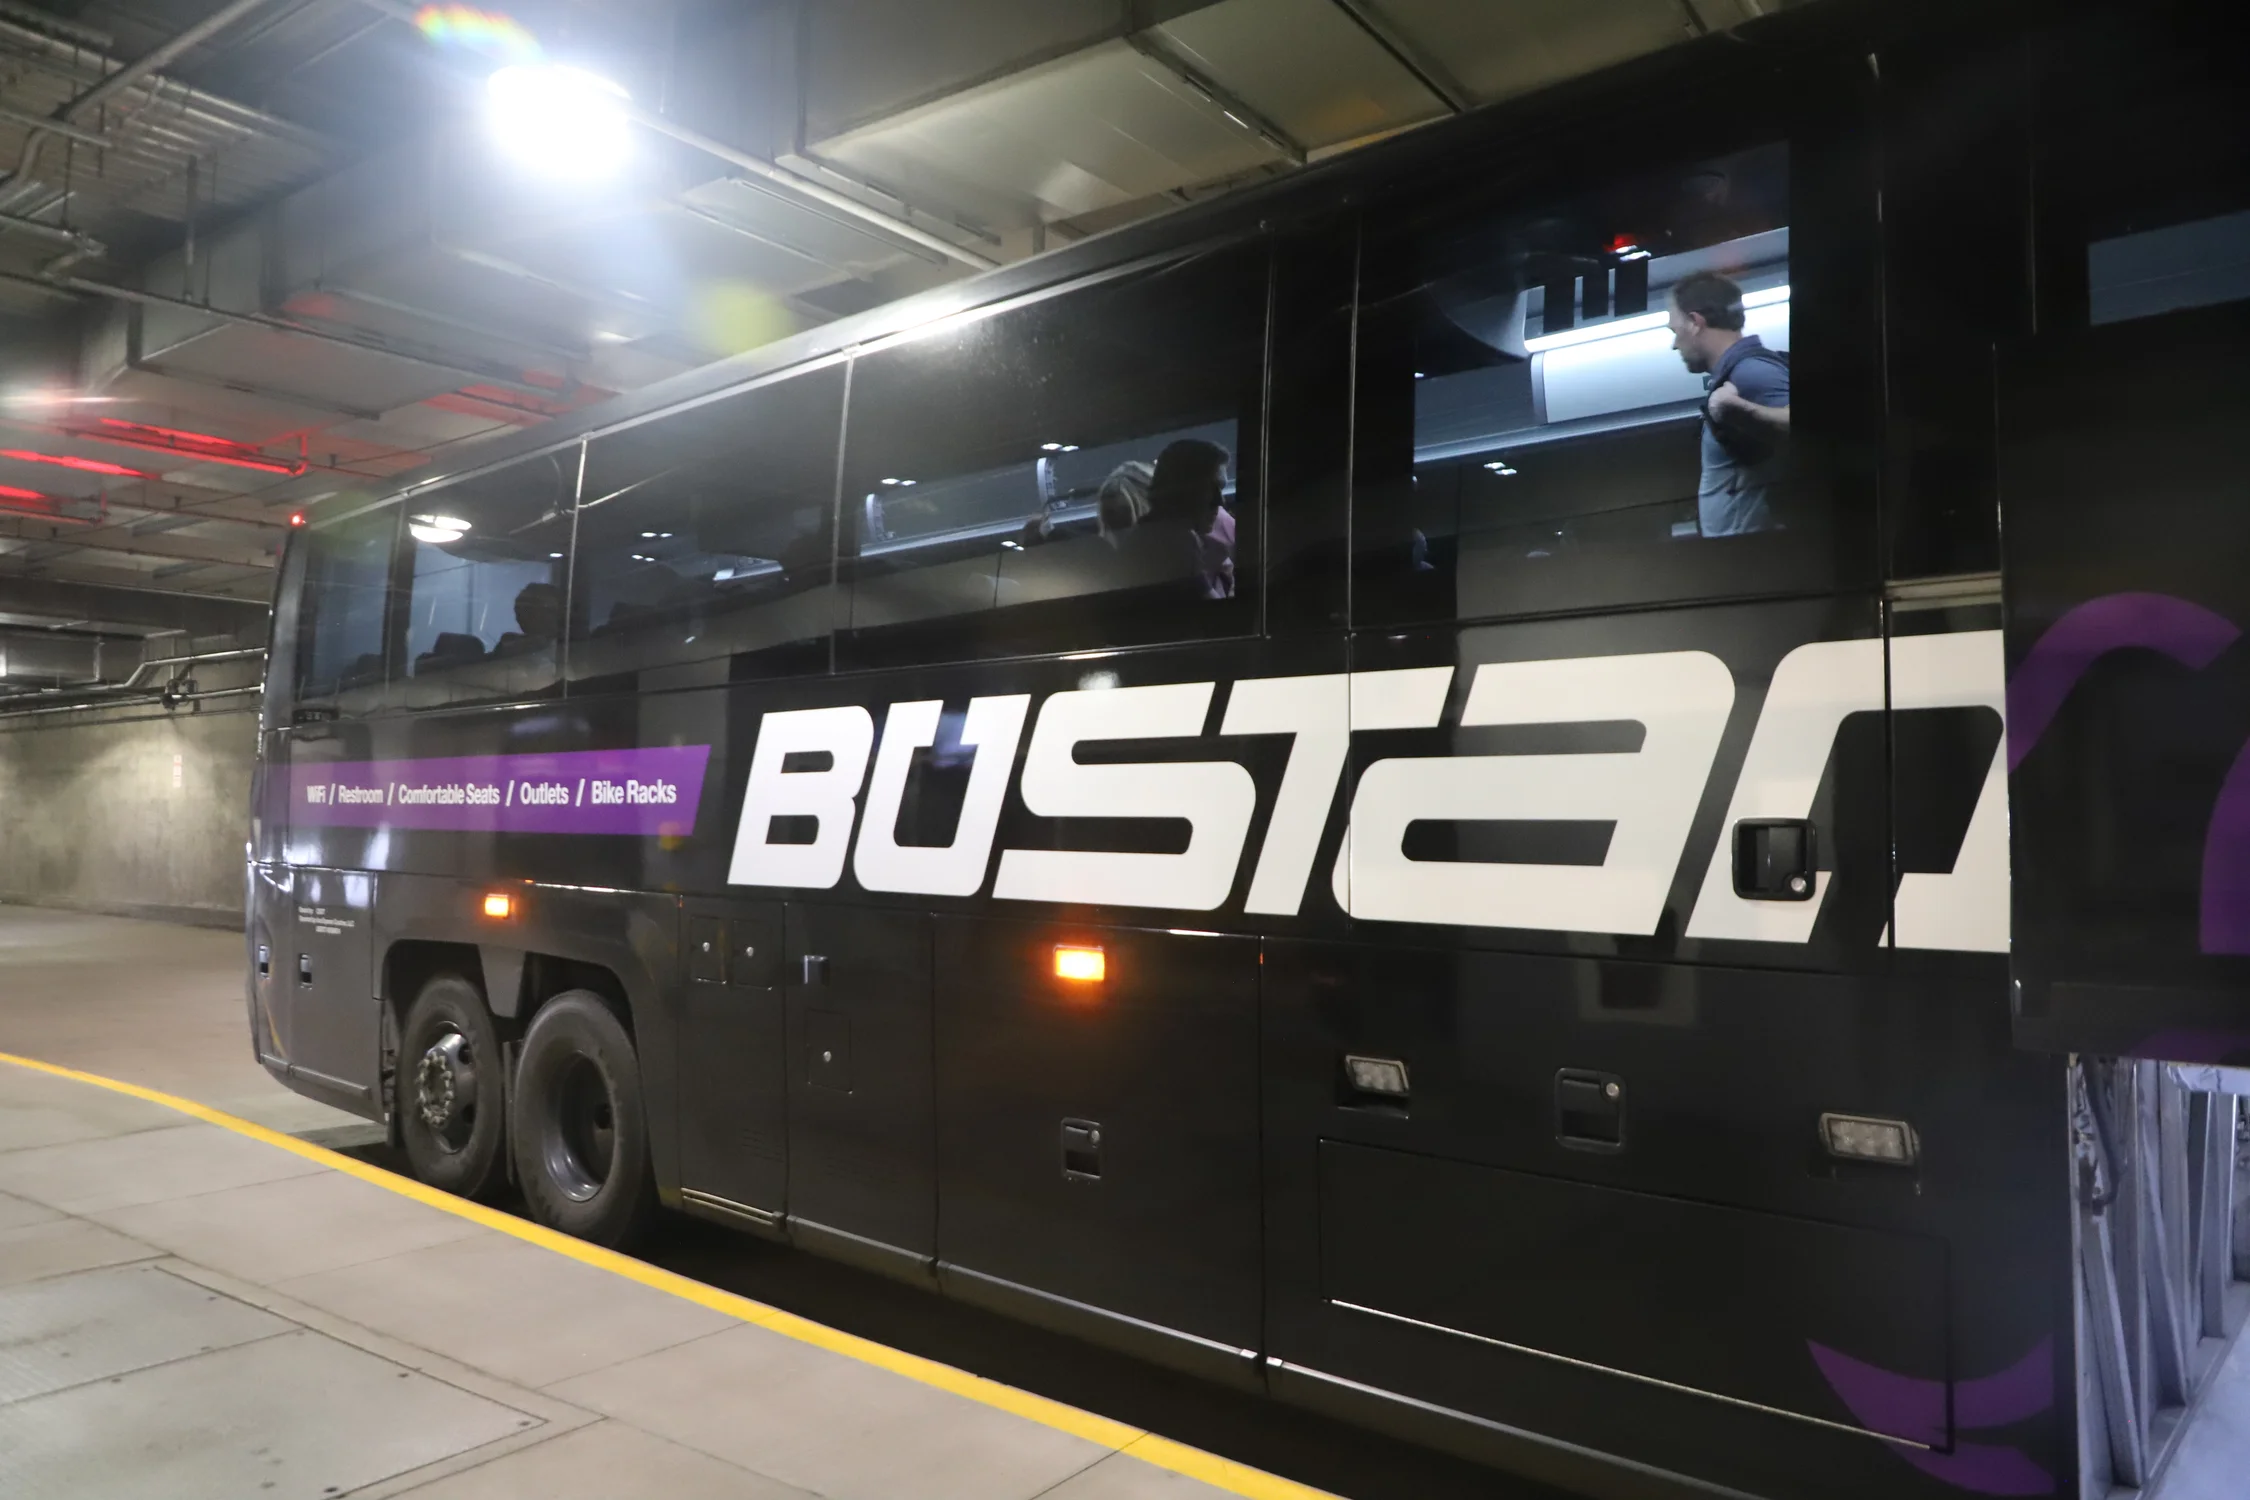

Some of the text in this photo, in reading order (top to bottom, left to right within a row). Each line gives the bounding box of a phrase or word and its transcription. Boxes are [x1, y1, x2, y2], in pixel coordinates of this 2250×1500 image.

[306, 785, 327, 804] WiFi
[338, 785, 385, 804] Restroom
[398, 783, 465, 805] Comfortable
[465, 782, 501, 805] Seats
[520, 781, 569, 805] Outlets
[591, 780, 625, 804] Bike
[626, 778, 677, 804] Racks
